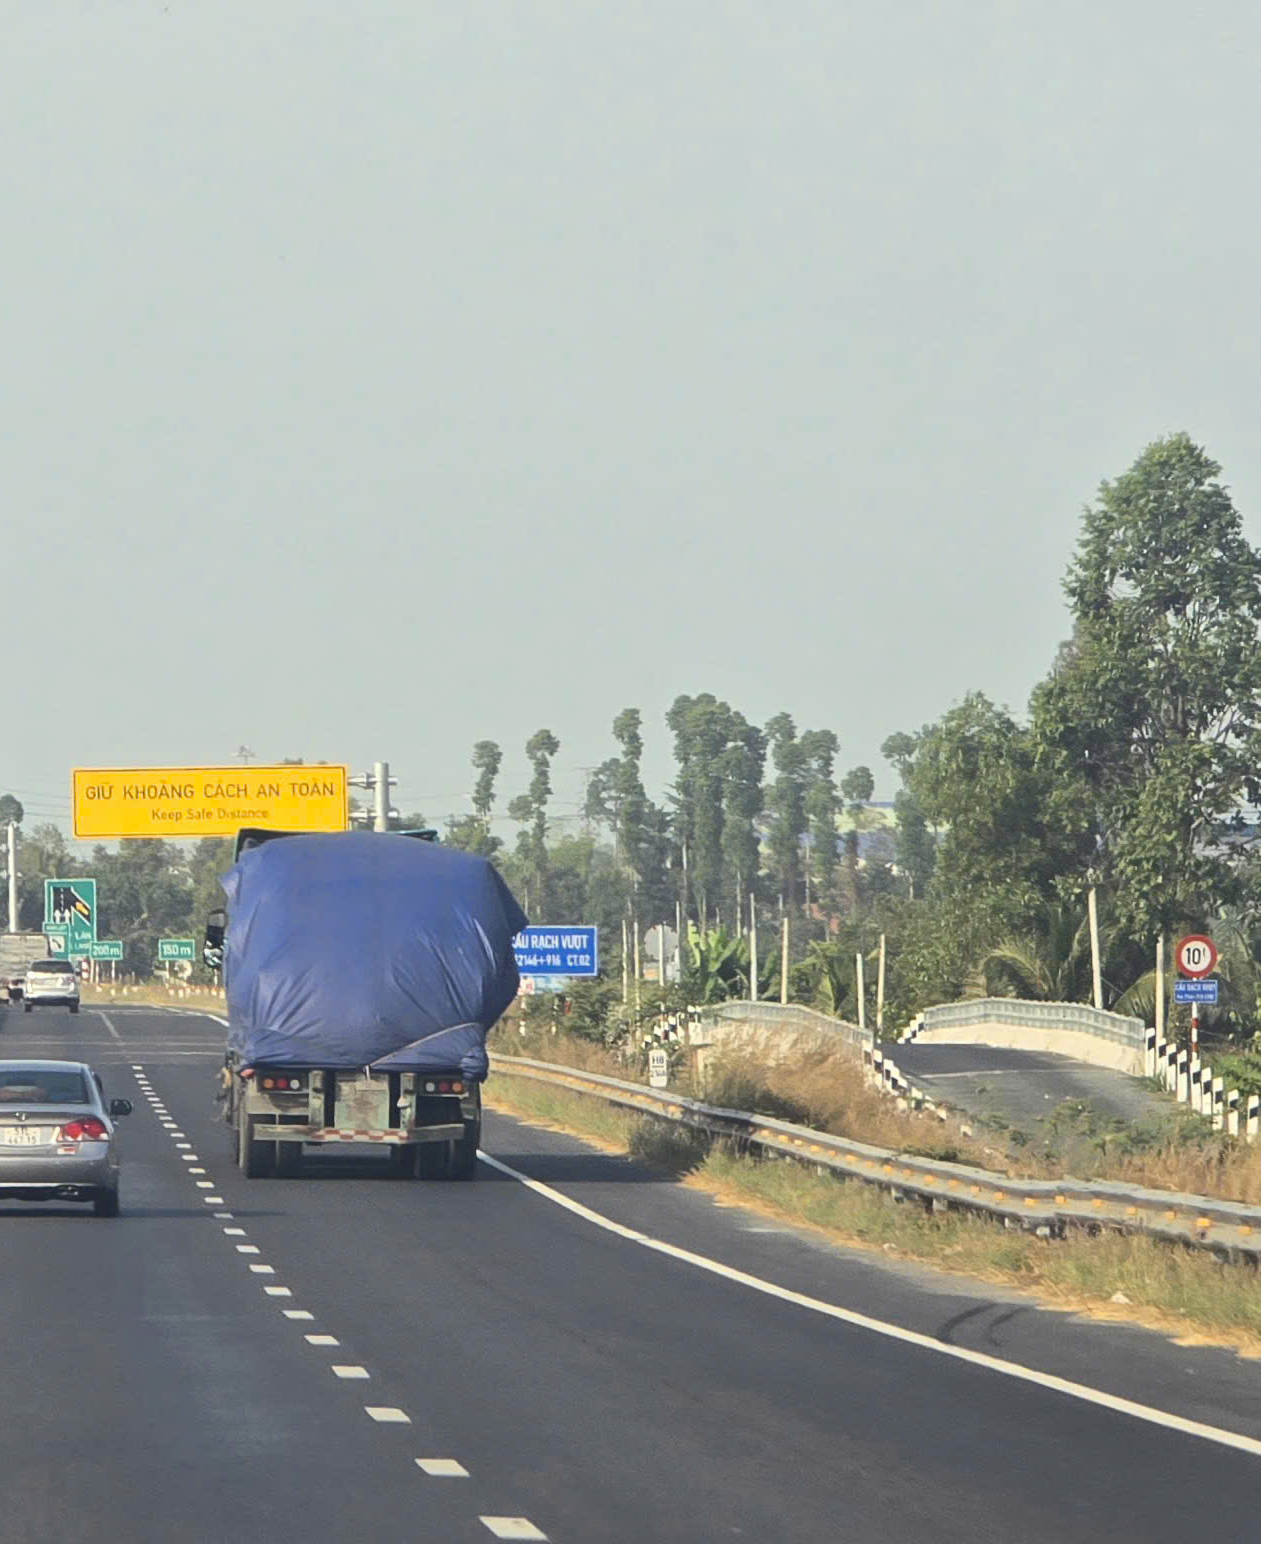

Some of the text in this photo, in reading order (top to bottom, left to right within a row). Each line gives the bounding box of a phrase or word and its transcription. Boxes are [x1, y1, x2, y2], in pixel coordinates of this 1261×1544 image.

[85, 777, 335, 800] GIỮ KHOẢNG CÁCH AN TOÀN
[152, 807, 269, 822] Keep Safe Distance
[163, 944, 191, 956] 150 m
